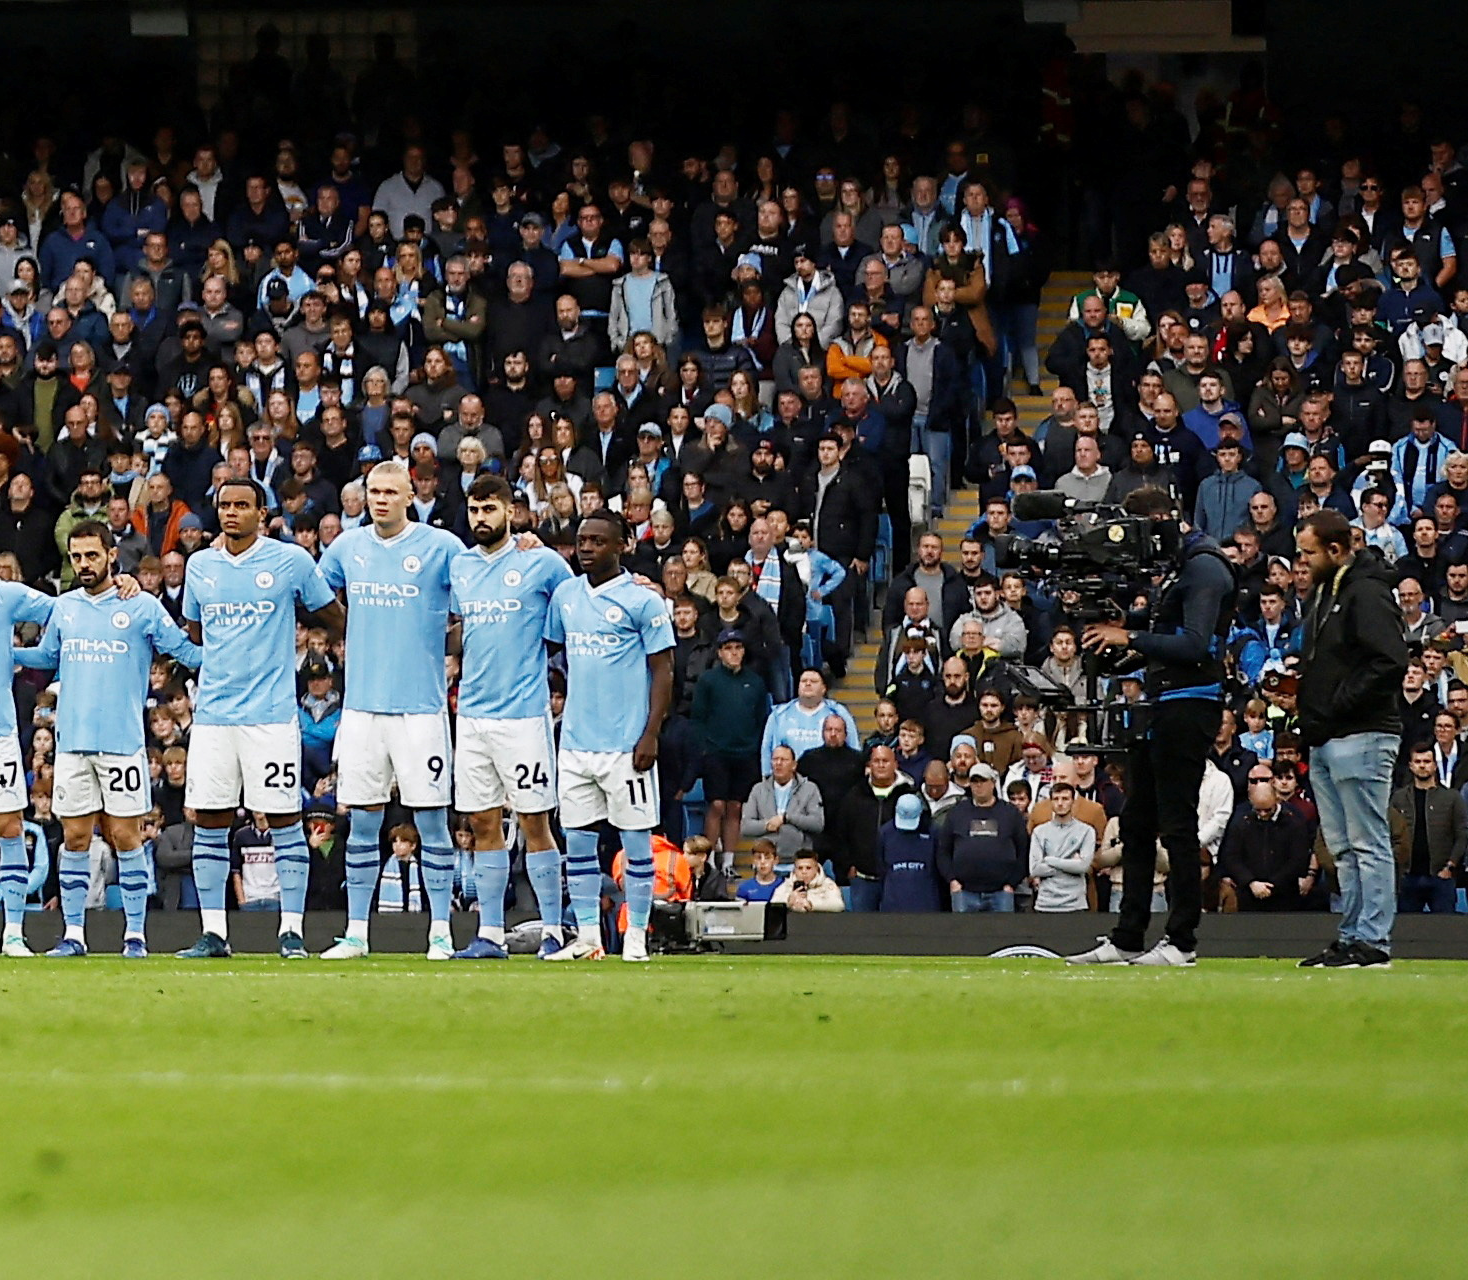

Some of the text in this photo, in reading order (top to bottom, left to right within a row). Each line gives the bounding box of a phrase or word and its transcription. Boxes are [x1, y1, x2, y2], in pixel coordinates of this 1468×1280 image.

[350, 581, 419, 597] ETIHAD
[204, 600, 275, 616] ETIHAD
[358, 597, 405, 607] AIRWAYS
[214, 615, 262, 626] AIRWAYS
[62, 638, 129, 654] ETIHAD
[565, 632, 620, 646] TIHAD
[67, 653, 114, 664] AIRWAYS
[264, 762, 297, 789] 25
[427, 755, 444, 782] 9
[515, 762, 549, 790] 24
[108, 766, 141, 792] 20
[625, 777, 647, 806] 11
